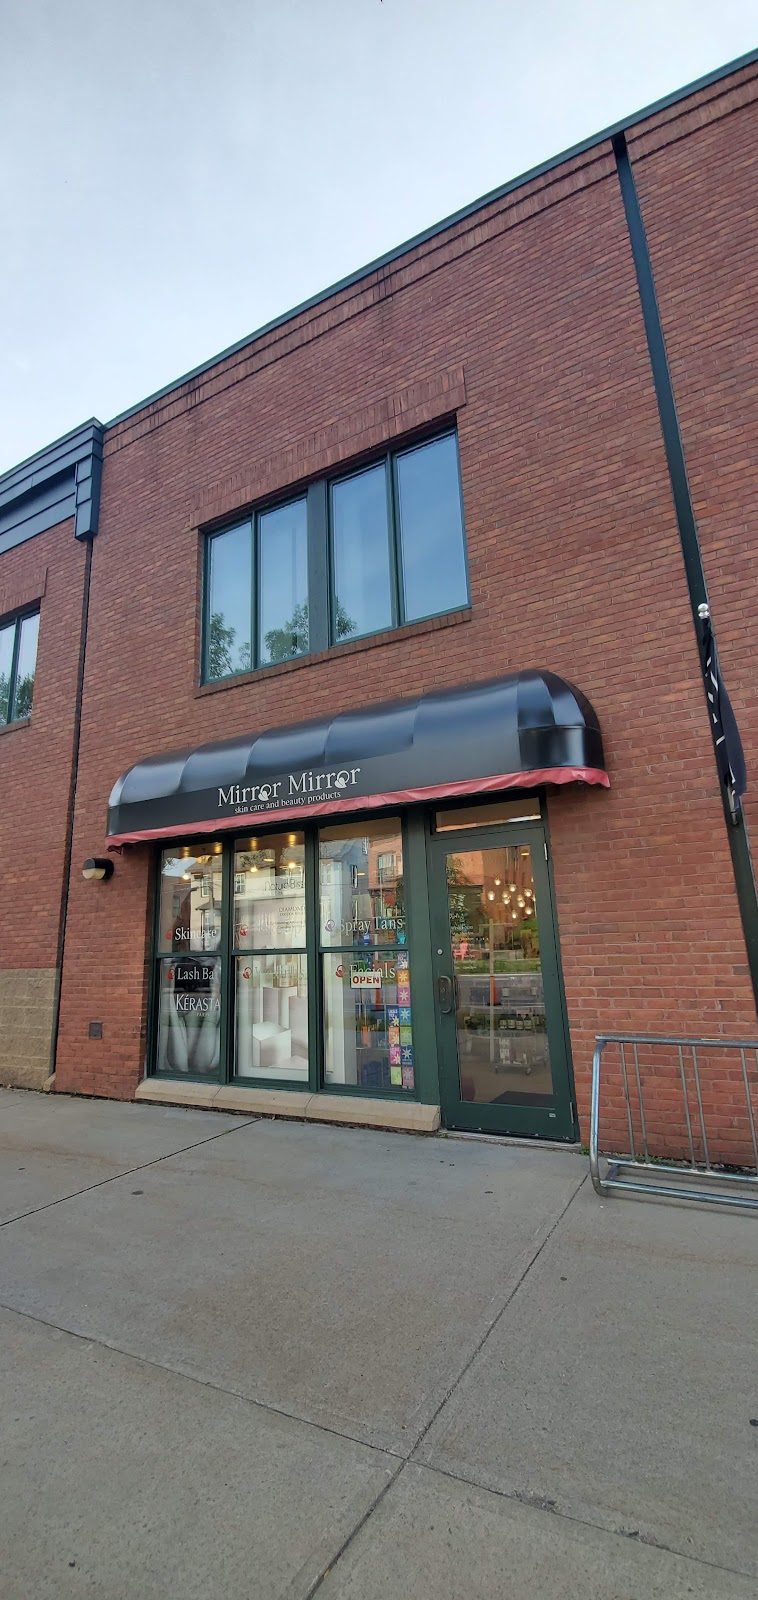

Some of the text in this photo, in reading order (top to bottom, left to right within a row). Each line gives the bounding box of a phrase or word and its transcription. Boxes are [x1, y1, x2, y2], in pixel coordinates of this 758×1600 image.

[217, 767, 361, 807] Mirror Mirror
[234, 791, 341, 814] skin care and beauty products
[175, 927, 217, 941] Skincare
[340, 916, 403, 936] Spray Tans
[177, 966, 217, 980] Lash Ba
[352, 975, 380, 984] OPEN
